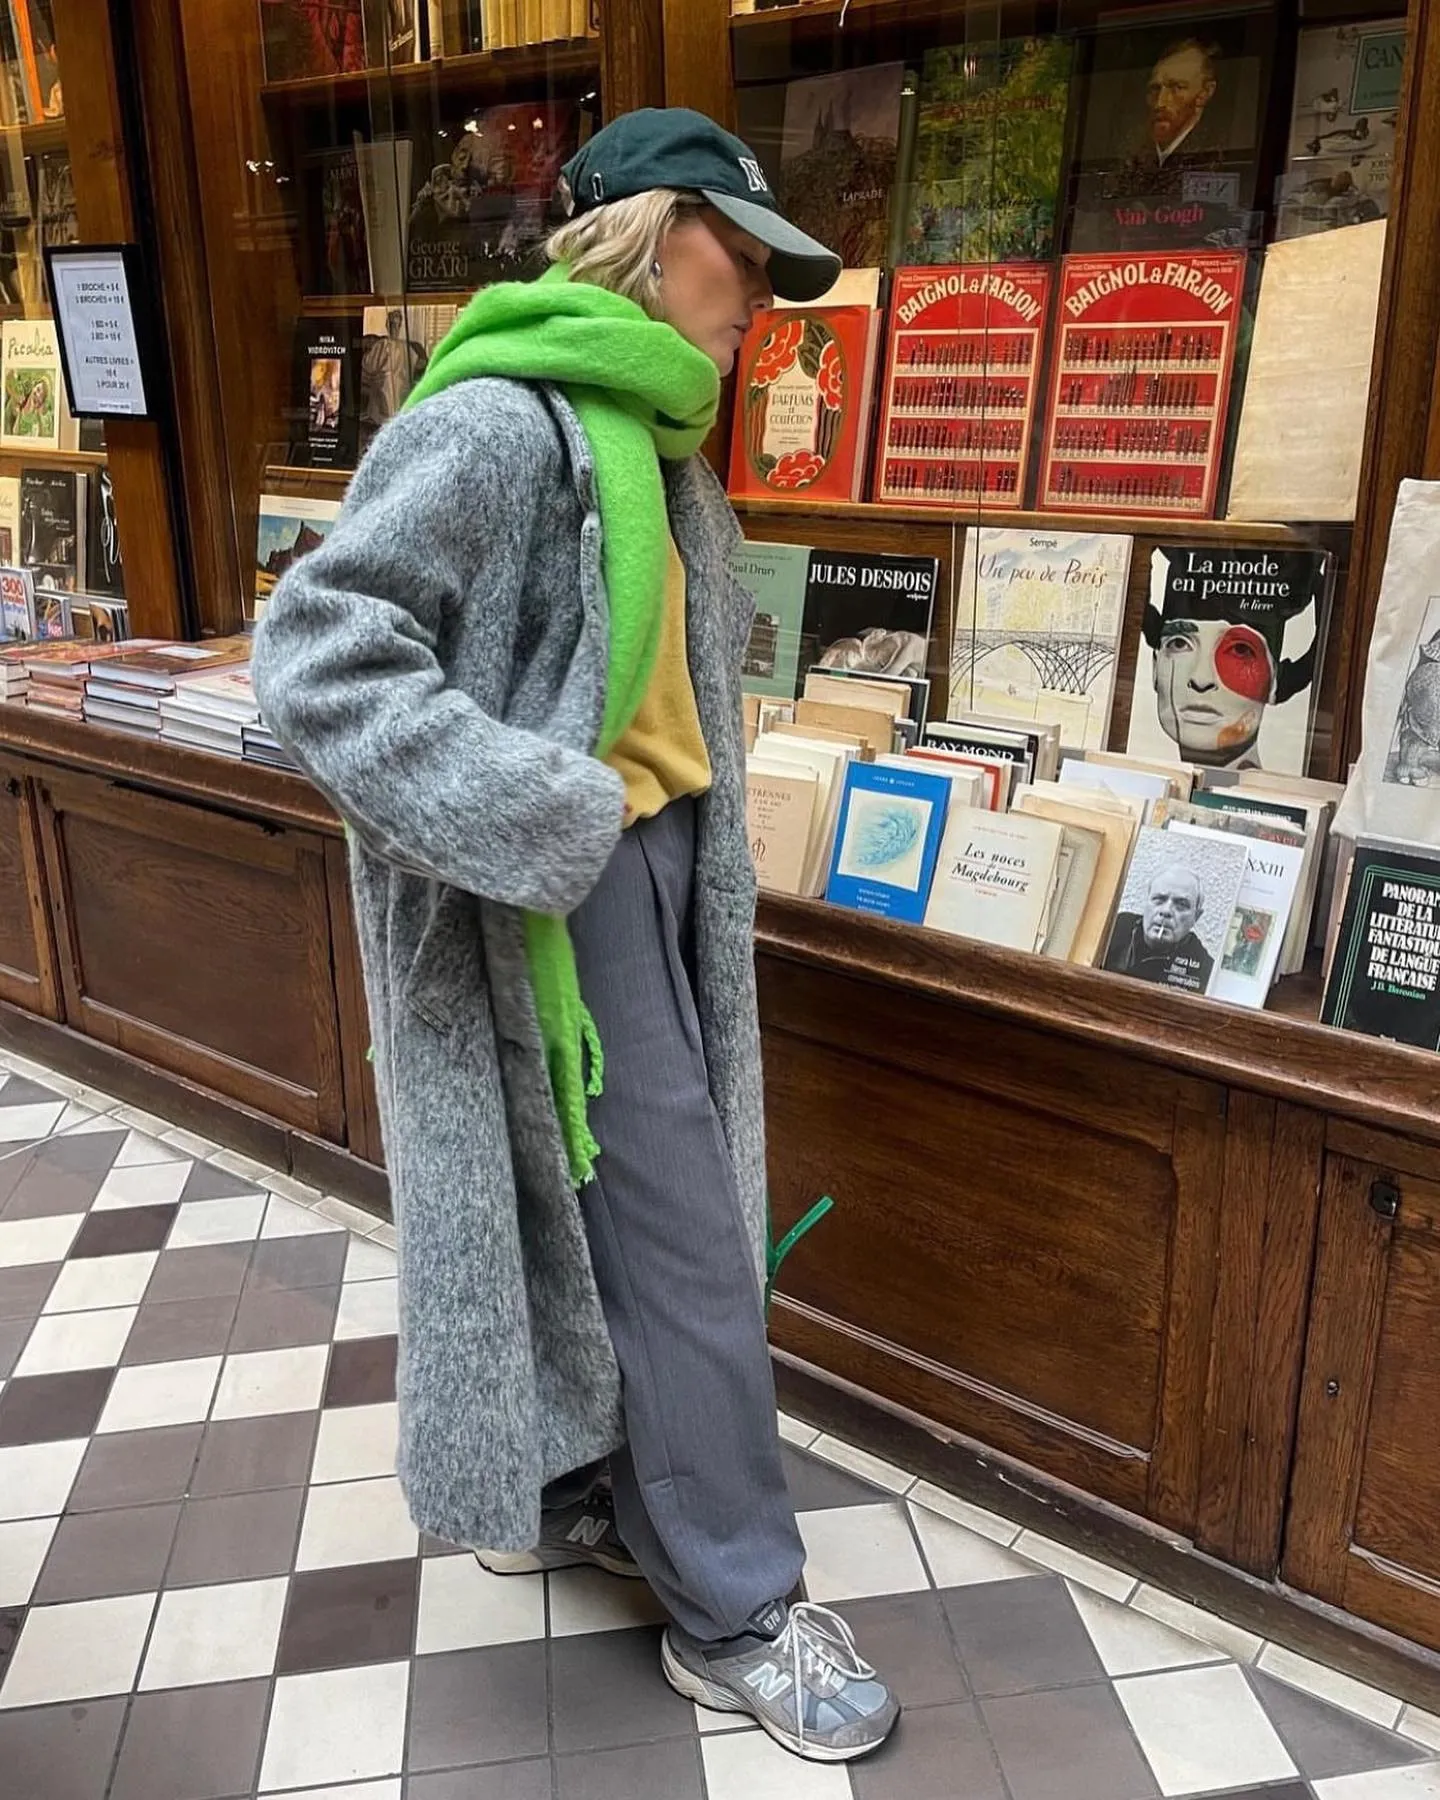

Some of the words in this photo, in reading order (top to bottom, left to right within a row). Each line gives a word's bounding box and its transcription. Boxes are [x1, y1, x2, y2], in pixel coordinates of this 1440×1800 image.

[1154, 203, 1205, 226] Gogh
[896, 273, 968, 324] BAIGNOL
[979, 273, 1041, 322] FARJON
[1065, 262, 1149, 318] BAIGNOL
[1150, 267, 1162, 284] &
[1162, 262, 1233, 315] FARJON
[809, 563, 856, 587] JULES
[861, 567, 932, 593] DESBOIS
[979, 553, 1002, 579] Un
[1009, 568, 1034, 584] peu
[1040, 565, 1057, 582] de
[1064, 558, 1108, 588] Paris
[1187, 552, 1213, 574] La
[1221, 554, 1279, 576] mode
[1172, 577, 1195, 592] en
[1201, 573, 1290, 600] peinture
[1240, 599, 1249, 609] le
[1251, 599, 1274, 611] livre
[927, 739, 1014, 761] RAYMOND
[965, 842, 985, 859] Les
[991, 852, 1025, 868] noces
[952, 862, 1029, 892] Magdebourg
[1397, 901, 1416, 918] DE
[1416, 905, 1433, 922] LA
[1371, 945, 1390, 963] DE
[1390, 949, 1440, 974] LANGUE
[1367, 962, 1437, 991] FRANÇAISE
[743, 1662, 793, 1701] N
